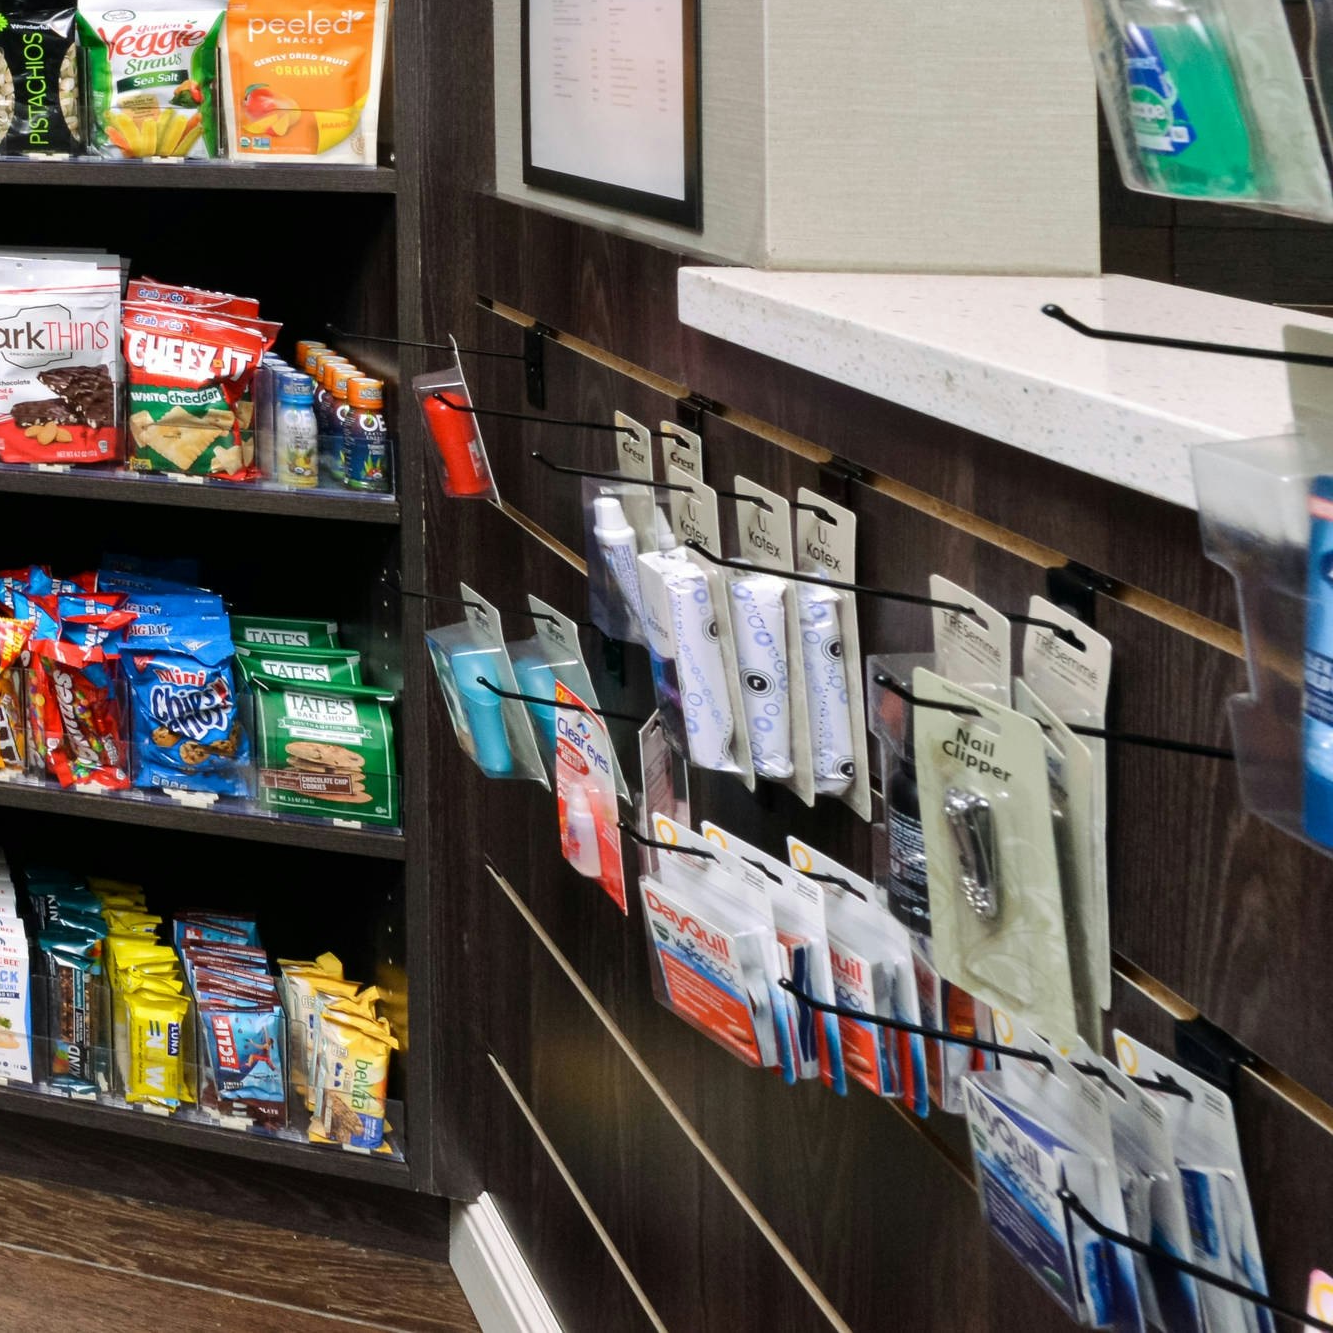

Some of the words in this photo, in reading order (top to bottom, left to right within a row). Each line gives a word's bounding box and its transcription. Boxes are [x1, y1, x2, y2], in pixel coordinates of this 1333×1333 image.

[136, 22, 183, 36] Garden
[247, 9, 354, 43] peeled
[97, 22, 207, 60] Veggie
[276, 34, 325, 45] SNACKS
[122, 53, 183, 77] Straws
[252, 53, 288, 68] GENTLY
[289, 51, 319, 62] DRIED
[319, 55, 350, 67] FRUIT
[132, 74, 155, 88] Sea
[157, 71, 180, 84] Salt
[276, 64, 332, 77] ORGANIC
[29, 32, 49, 145] PISTACHIOS
[137, 288, 160, 300] Grab
[169, 292, 184, 303] Go
[134, 314, 157, 327] Grab
[167, 320, 183, 332] Go
[130, 390, 167, 404] WHITE
[168, 389, 220, 406] cheddar
[622, 441, 645, 464] Crest
[670, 451, 695, 472] Crest
[679, 520, 710, 549] kotex
[748, 524, 782, 559] kotex
[805, 537, 842, 573] kotex
[137, 604, 162, 616] BAG
[147, 623, 171, 636] BAG
[153, 667, 206, 687] Mini
[151, 685, 217, 722] Chips
[291, 694, 353, 716] TATE'S
[297, 710, 320, 720] BAKE
[323, 713, 347, 723] SHOP
[556, 716, 586, 749] Clear
[586, 739, 611, 776] eyes
[956, 727, 995, 758] Nail
[941, 739, 1013, 783] Clipper
[301, 776, 333, 785] CHOCOLATE
[334, 777, 349, 786] CHIP
[301, 783, 327, 791] COOKIES
[0, 926, 16, 934] BEE
[645, 888, 730, 958] DayQuil
[2, 956, 20, 967] BEE
[0, 983, 17, 991] RUN!
[170, 1024, 179, 1054] LUNA
[216, 1018, 237, 1057] CLIF
[68, 1044, 82, 1077] KIND
[352, 1058, 373, 1110] belVita
